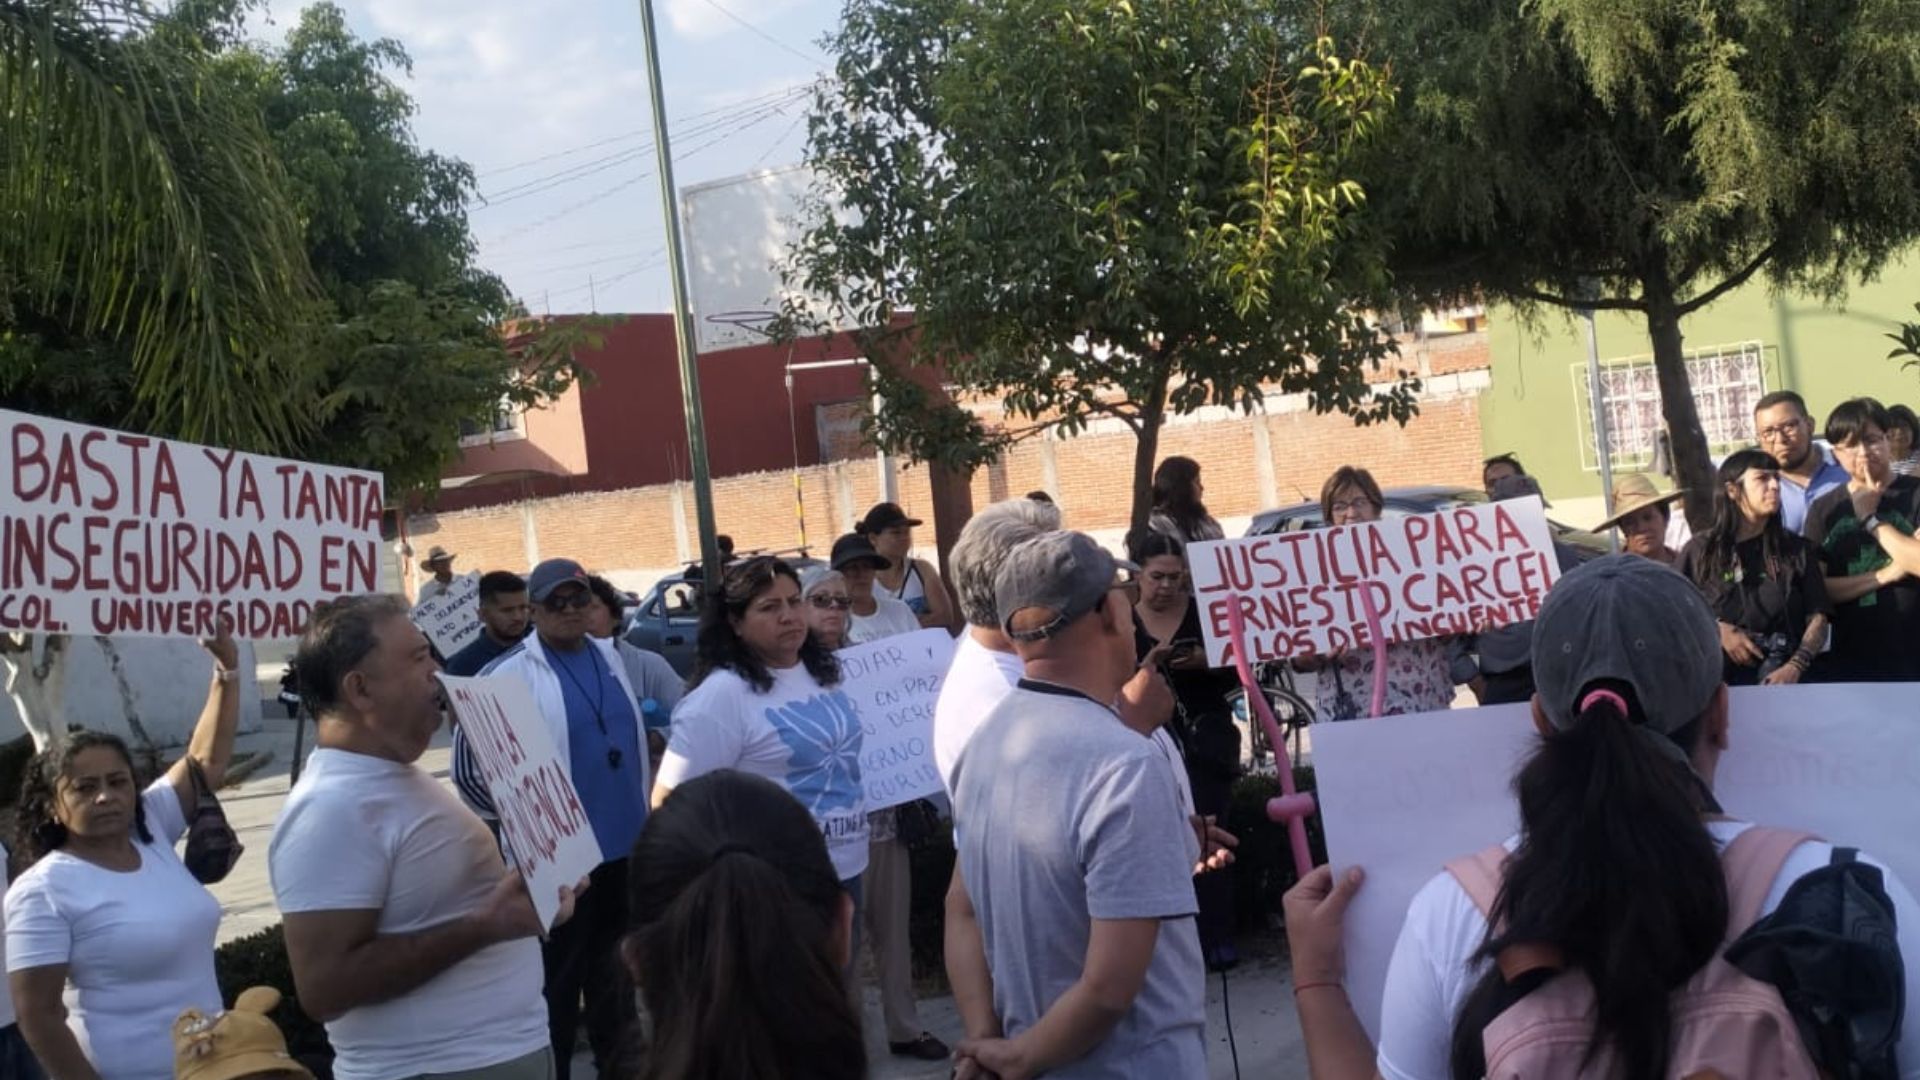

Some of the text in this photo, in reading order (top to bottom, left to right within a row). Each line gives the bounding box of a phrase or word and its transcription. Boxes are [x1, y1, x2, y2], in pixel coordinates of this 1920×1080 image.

[12, 423, 384, 537] BASTA YA TANTA
[2, 512, 377, 595] INSEGURIDAD EN
[1199, 504, 1529, 593] JUSTICIA PARA
[0, 595, 68, 631] COL.
[842, 646, 907, 680] DIAR
[1254, 629, 1318, 661] LOS
[902, 674, 940, 697] PAZ
